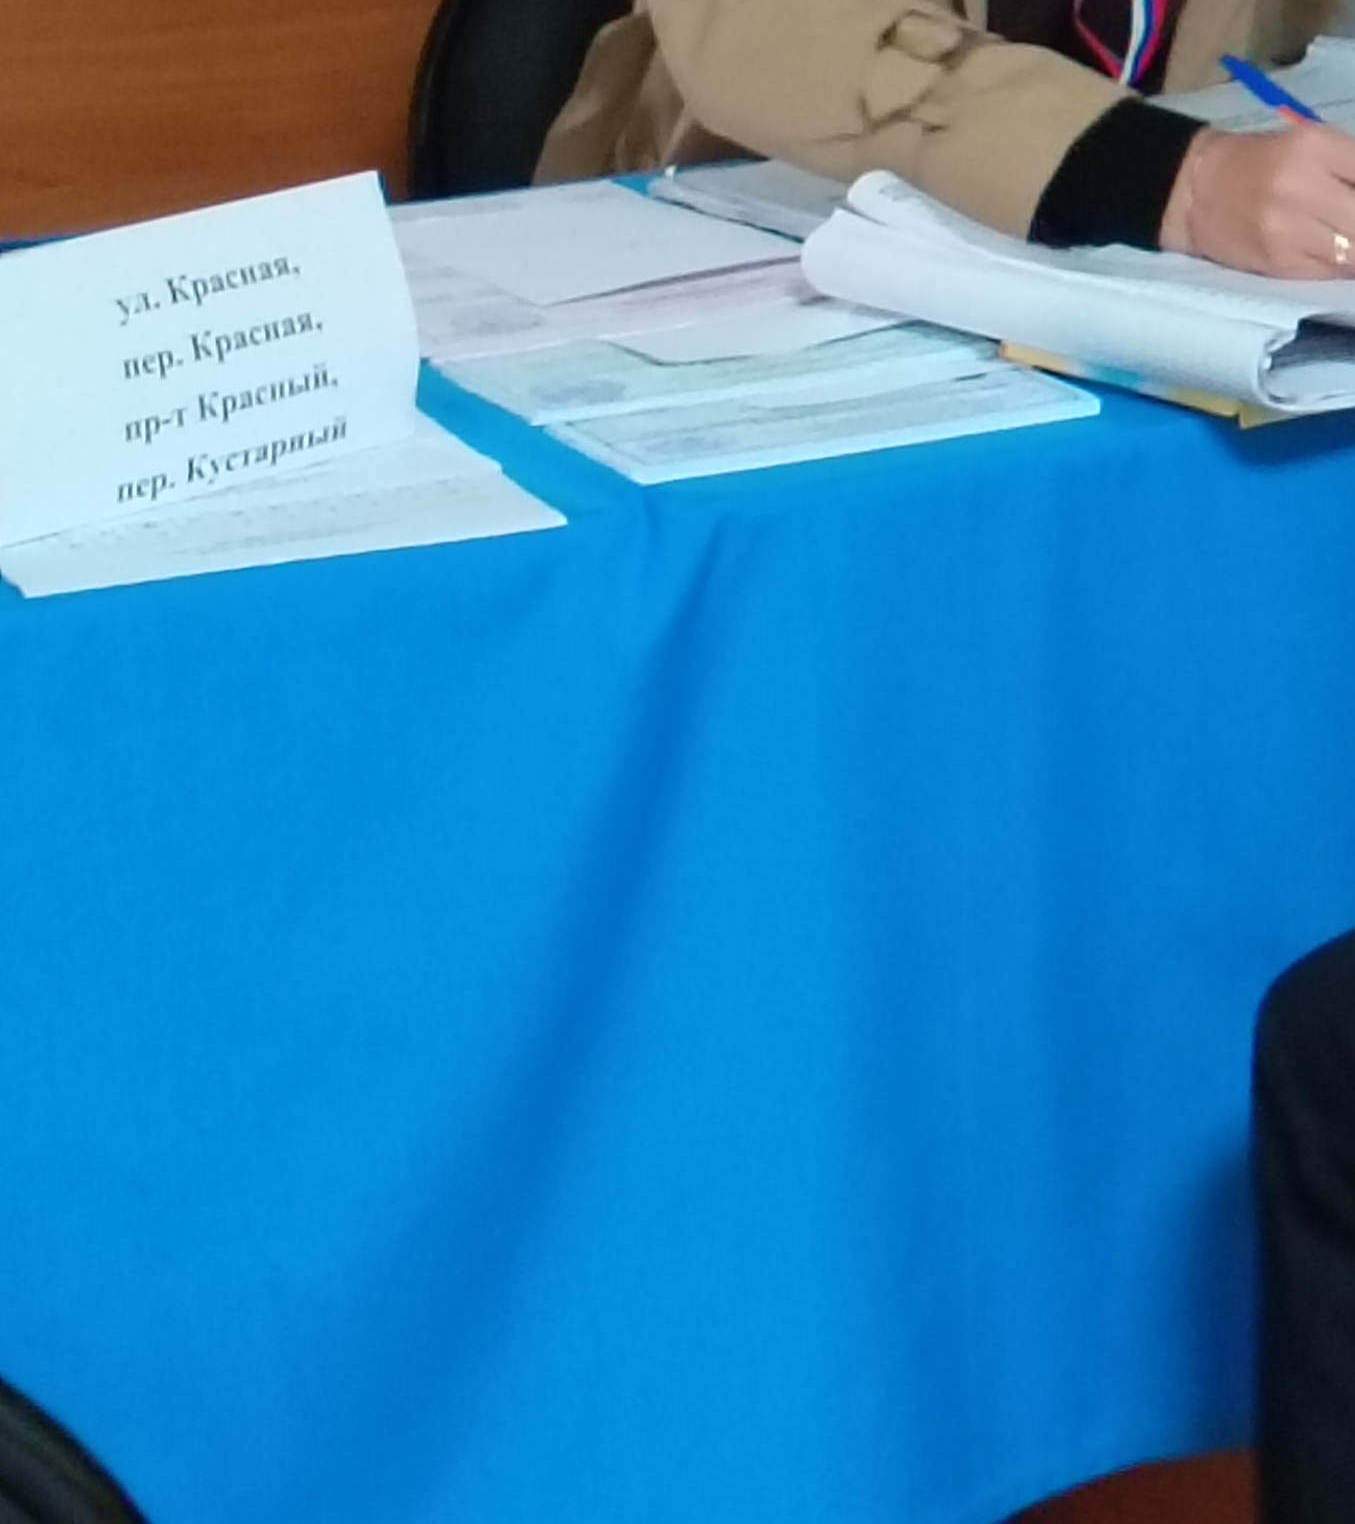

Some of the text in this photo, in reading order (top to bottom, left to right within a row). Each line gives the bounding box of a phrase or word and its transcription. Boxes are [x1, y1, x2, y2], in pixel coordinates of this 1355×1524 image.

[115, 255, 301, 327] ул. Красная,
[122, 311, 324, 380] пер. Красная,
[125, 362, 339, 445] пр-т Красный,
[116, 414, 348, 504] пер. Кустарный
